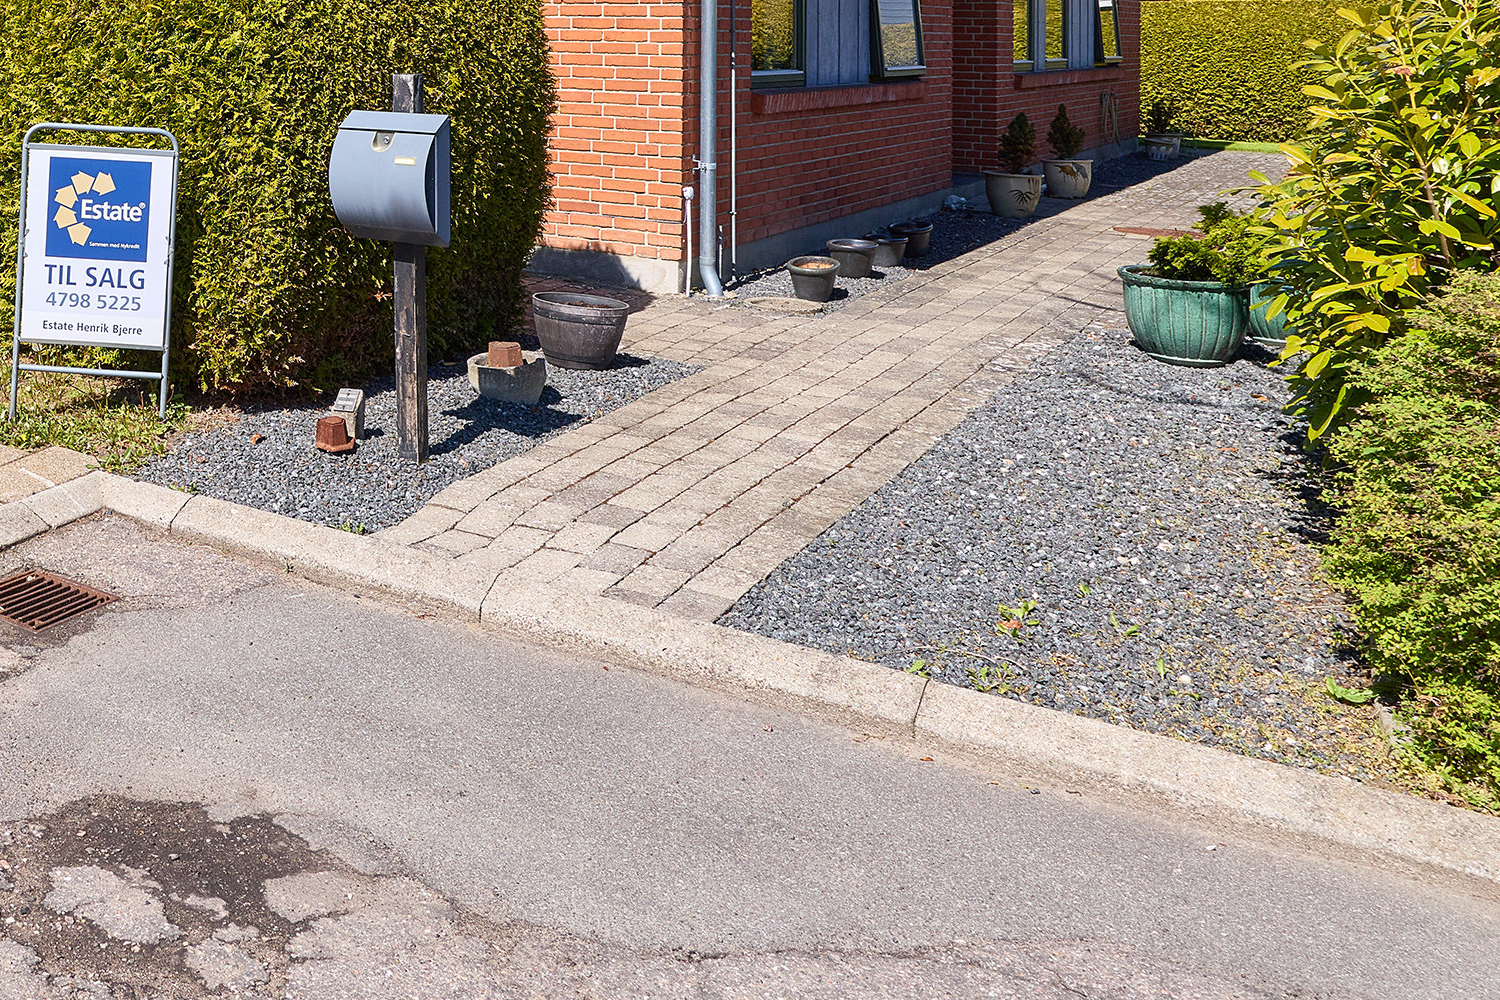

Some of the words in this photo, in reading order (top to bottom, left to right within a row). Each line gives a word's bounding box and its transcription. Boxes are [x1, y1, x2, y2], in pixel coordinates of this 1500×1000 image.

[80, 198, 143, 222] Estate
[44, 264, 77, 286] TIL
[85, 266, 145, 290] SALG
[45, 292, 91, 309] 4798
[97, 294, 141, 311] 5225
[42, 320, 74, 331] Estate
[76, 322, 109, 333] Henrik
[112, 324, 143, 336] Bjerre
